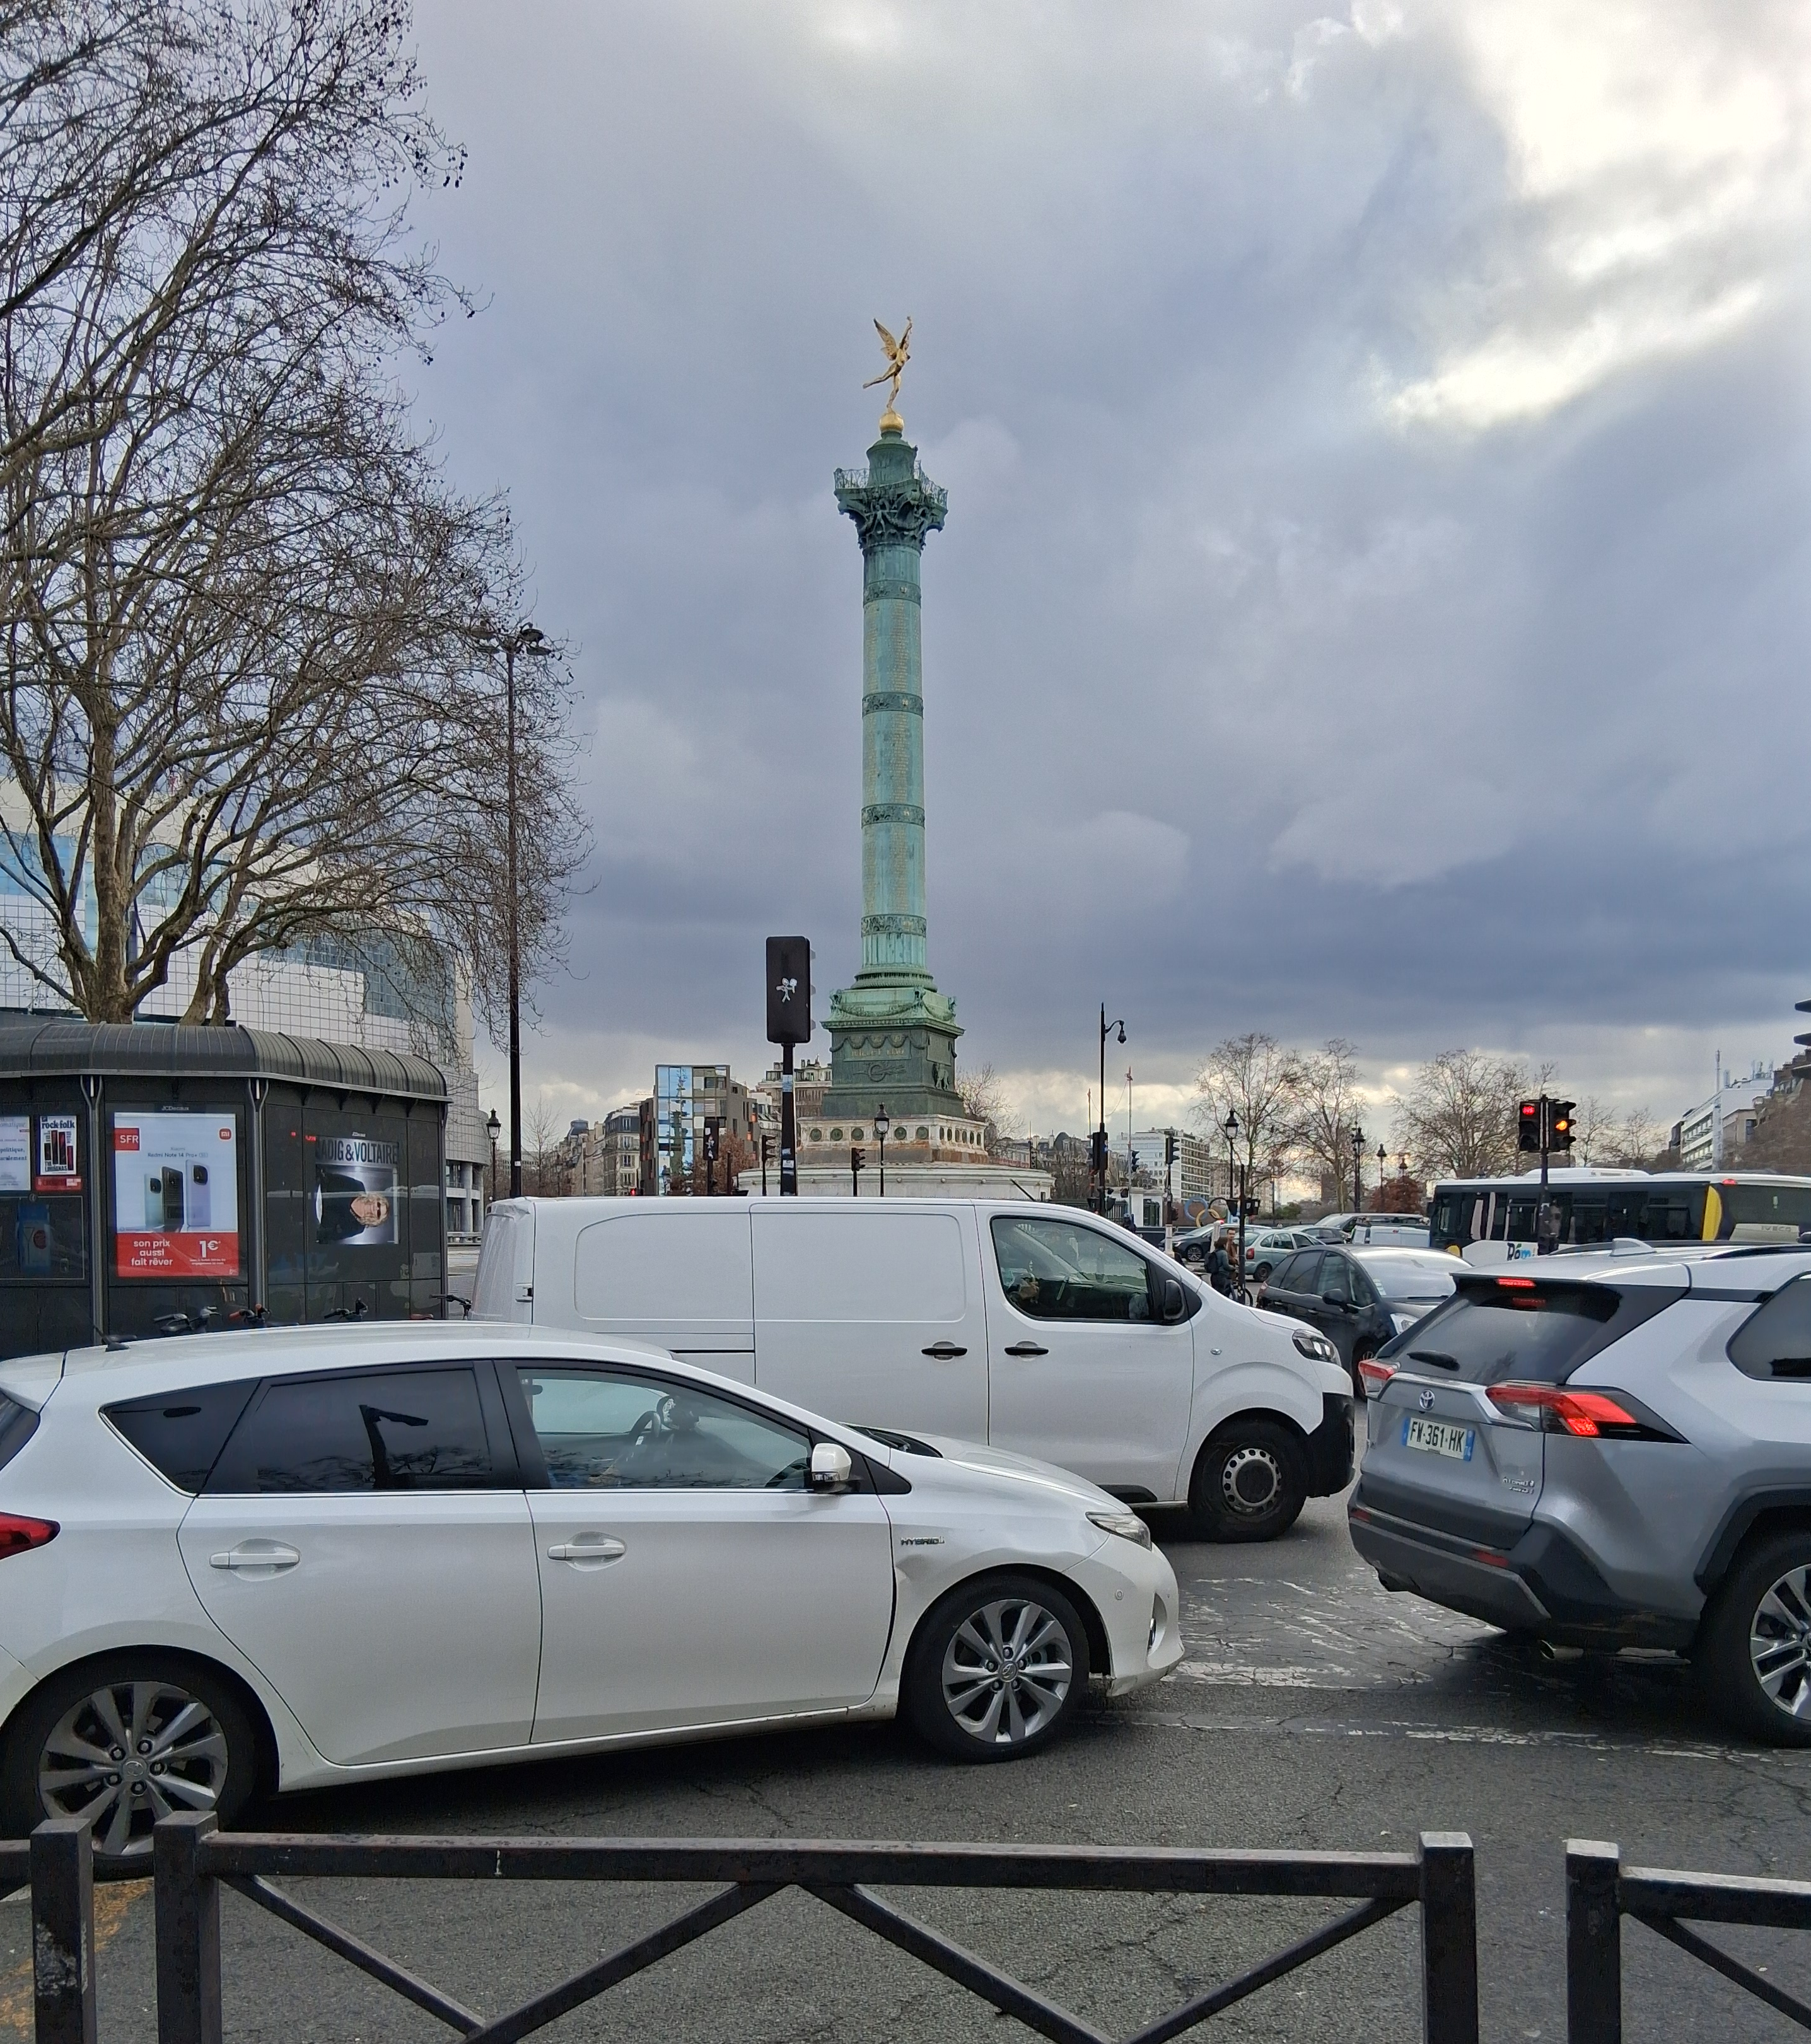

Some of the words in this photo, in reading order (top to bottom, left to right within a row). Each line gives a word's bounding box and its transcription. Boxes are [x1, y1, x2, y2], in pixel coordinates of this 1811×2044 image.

[153, 1240, 170, 1248] prix
[131, 1258, 148, 1266] fait
[149, 1258, 173, 1266] rêver
